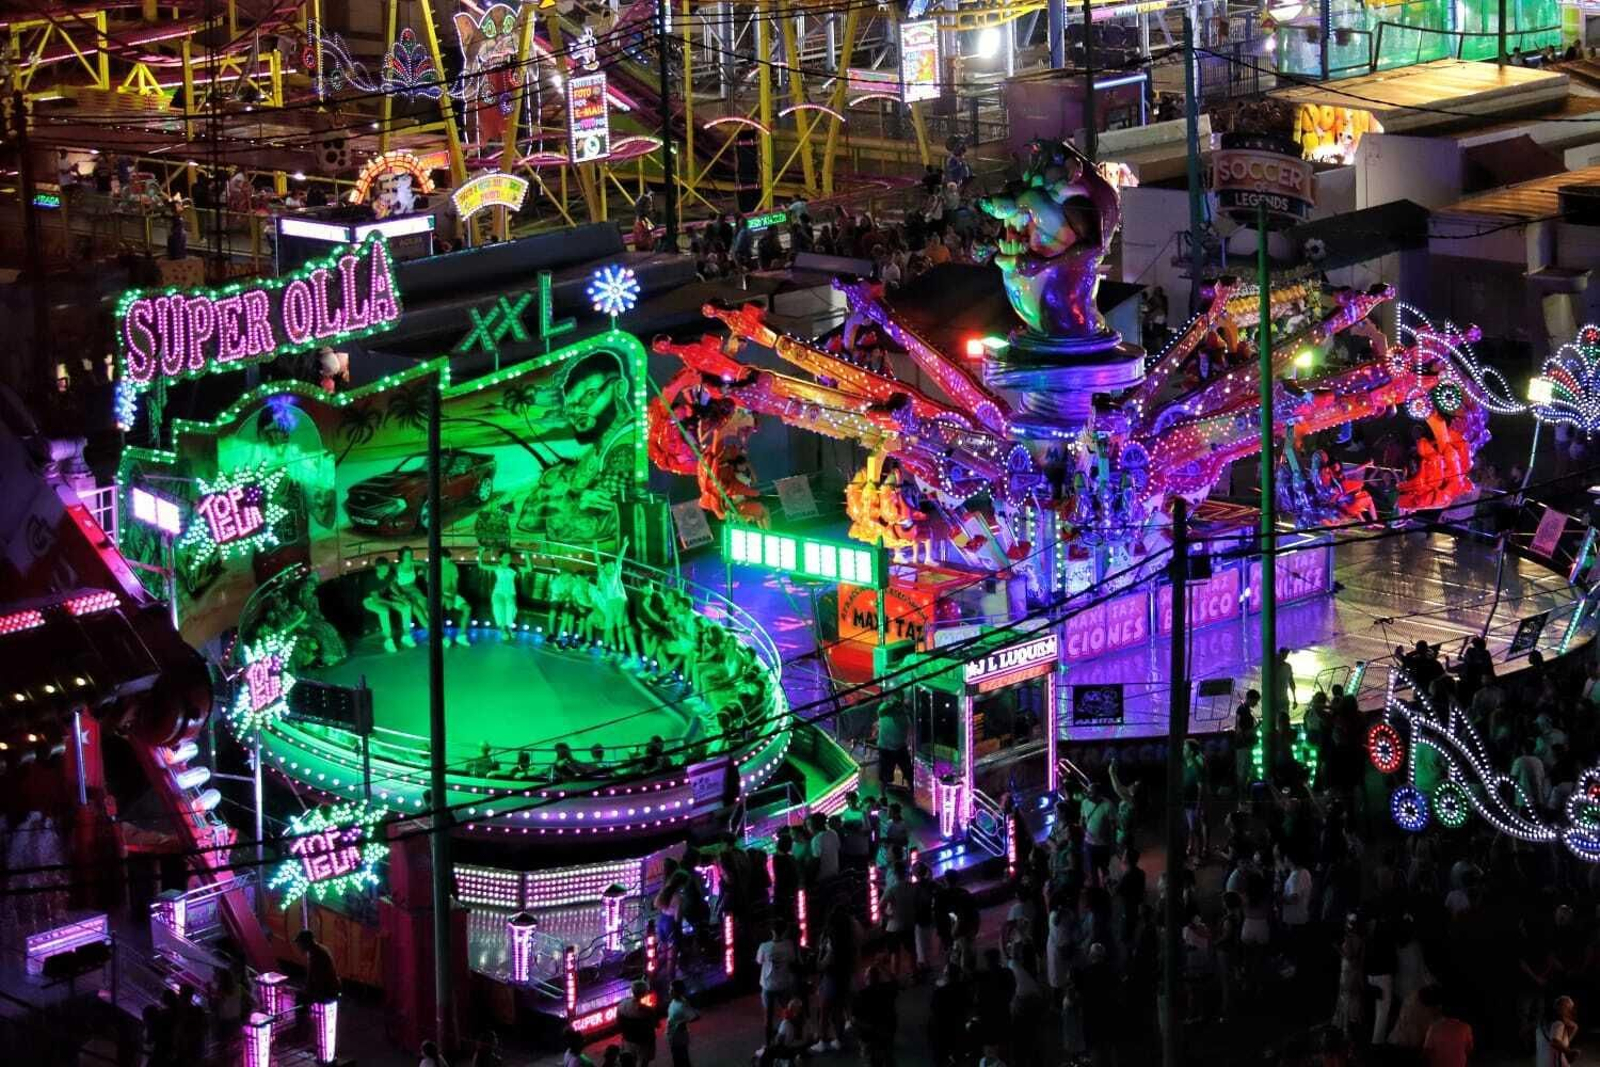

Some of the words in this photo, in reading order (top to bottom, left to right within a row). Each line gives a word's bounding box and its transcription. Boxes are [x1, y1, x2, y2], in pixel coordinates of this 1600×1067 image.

[573, 87, 592, 99] FOTO
[1220, 160, 1301, 190] SOCCER
[1235, 192, 1289, 211] LEGENDS
[125, 291, 275, 383] SUPER
[283, 240, 399, 345] OLLA
[460, 272, 575, 351] XXL
[1067, 616, 1144, 656] CIONES
[988, 657, 997, 671] L
